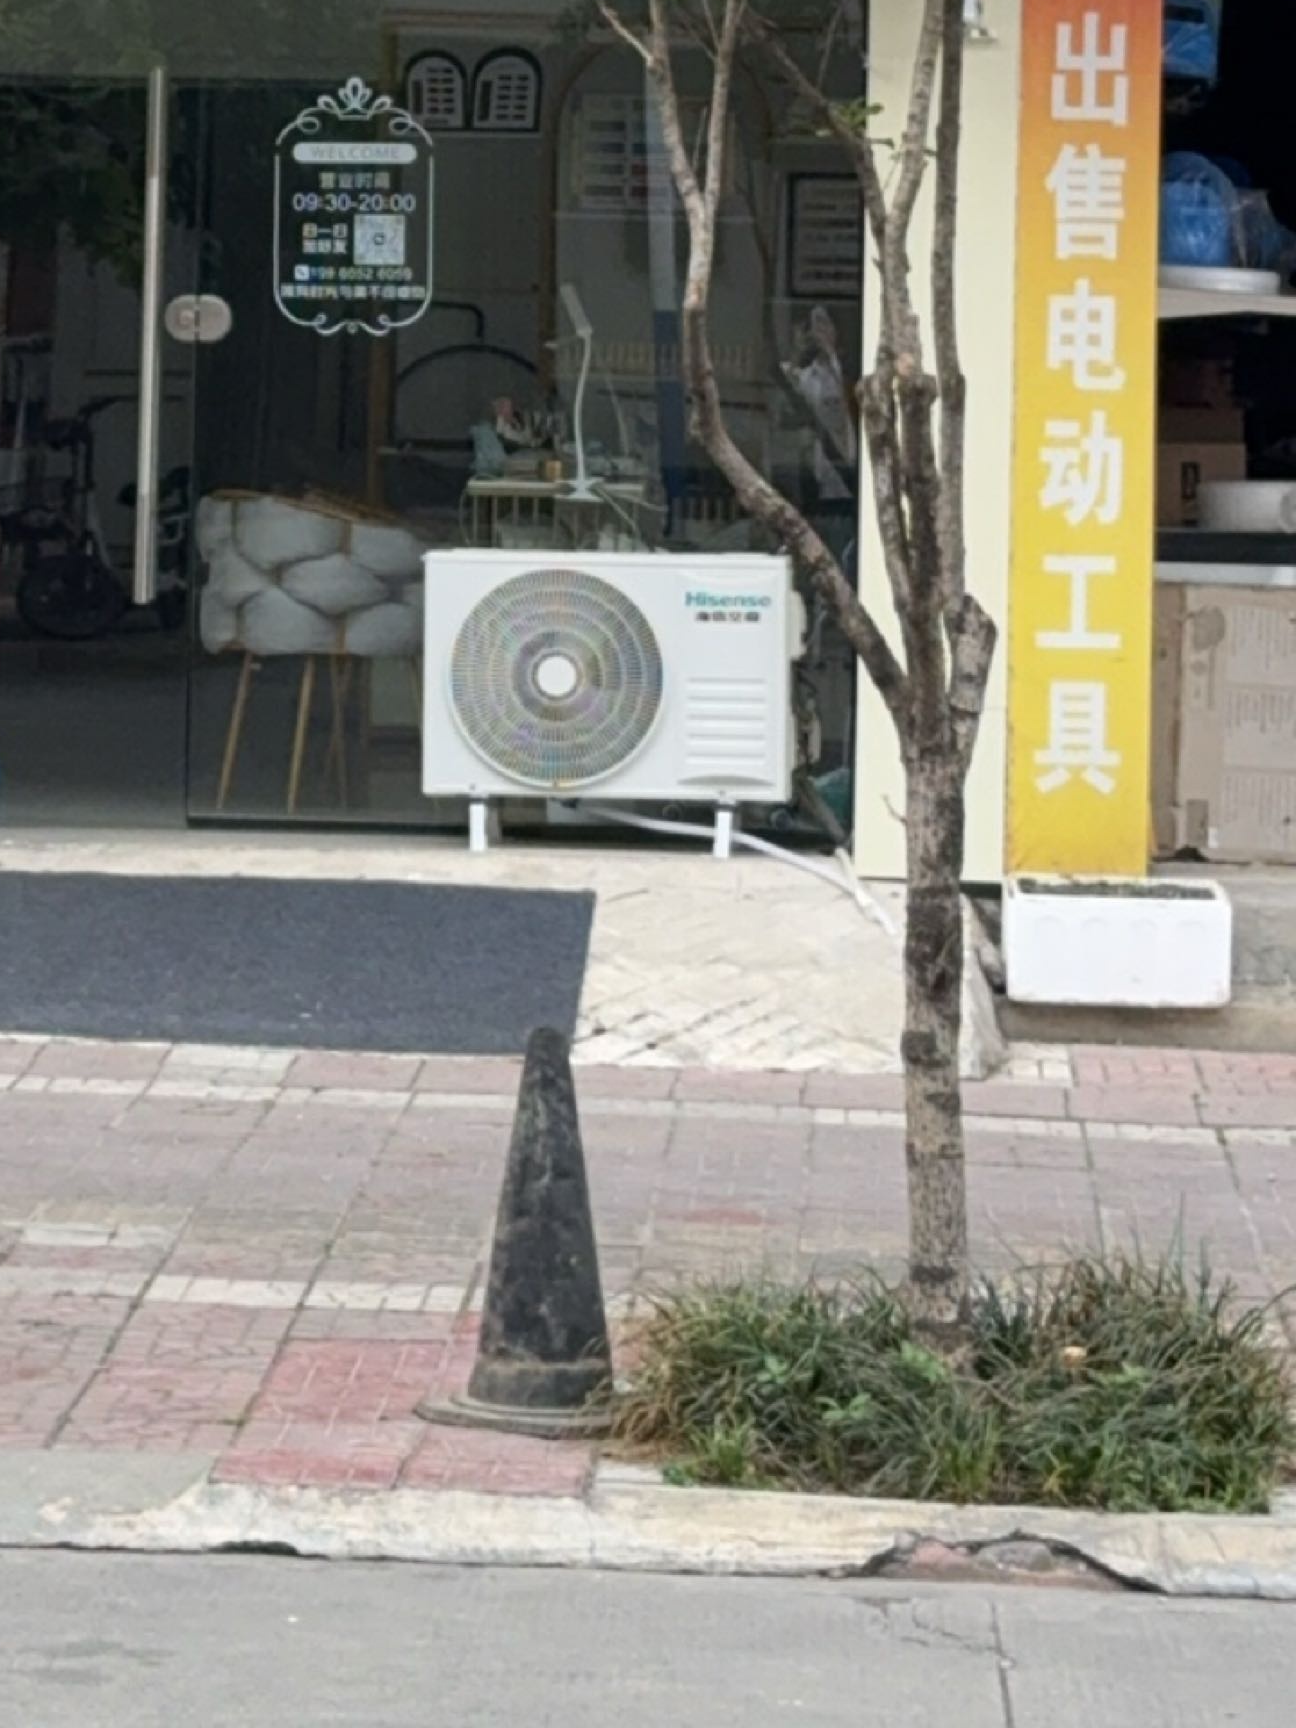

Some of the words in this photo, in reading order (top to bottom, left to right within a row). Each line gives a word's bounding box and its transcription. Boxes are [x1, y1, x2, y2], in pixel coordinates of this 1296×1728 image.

[310, 144, 401, 161] WELCOME
[292, 193, 416, 212] 09:30-20:00
[685, 591, 772, 607] Hisense
